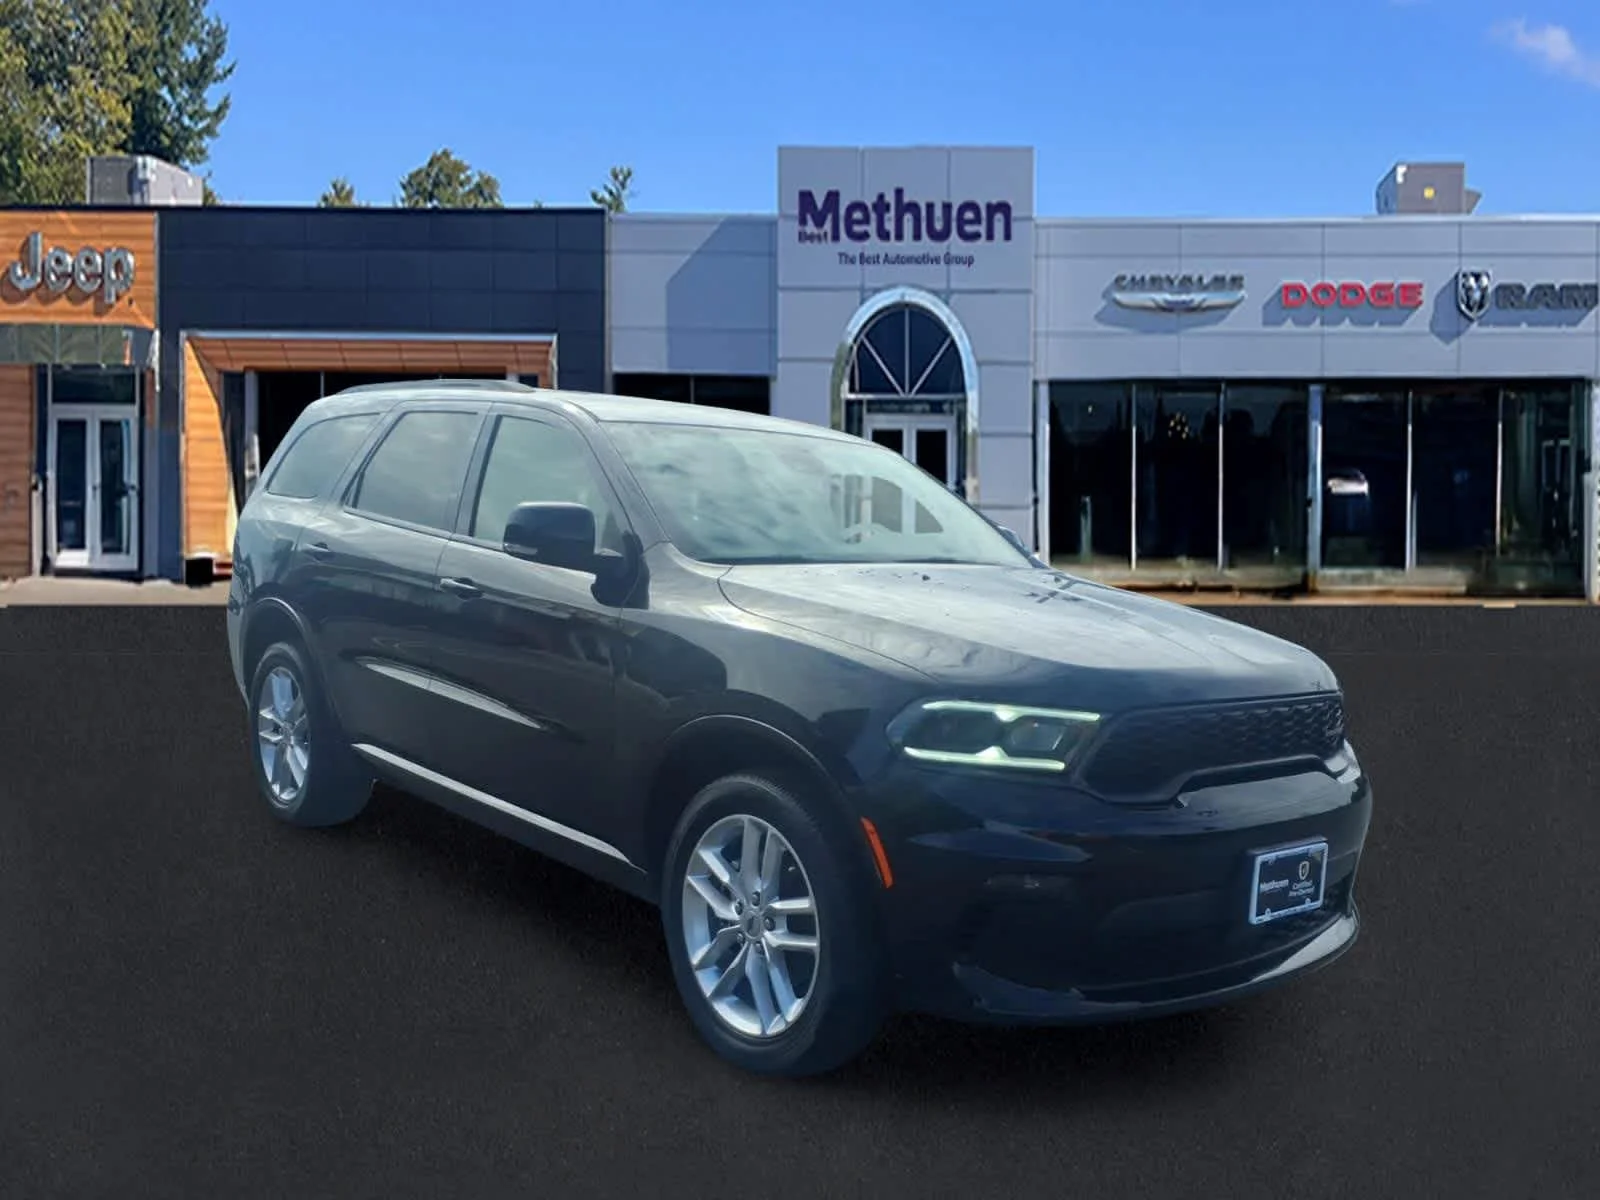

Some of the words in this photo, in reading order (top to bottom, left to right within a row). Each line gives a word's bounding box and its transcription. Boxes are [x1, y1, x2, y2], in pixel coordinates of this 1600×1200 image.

[798, 187, 1012, 242] Methuen
[9, 231, 134, 304] Jeep
[838, 252, 857, 265] The
[859, 252, 881, 265] Best
[883, 252, 941, 265] Automotive
[943, 252, 975, 268] Group
[1114, 274, 1245, 291] CHRYSLER
[1281, 282, 1423, 308] DODGE
[1495, 283, 1599, 309] RAM
